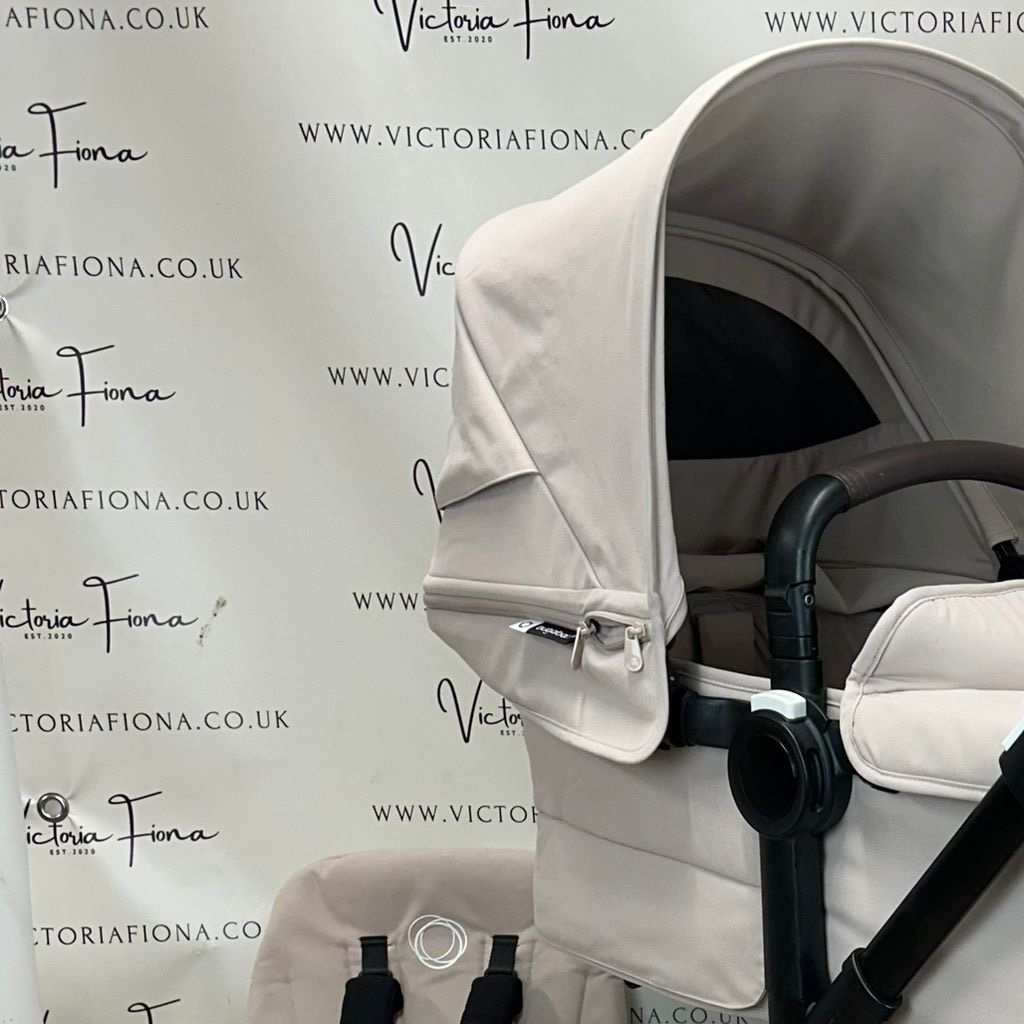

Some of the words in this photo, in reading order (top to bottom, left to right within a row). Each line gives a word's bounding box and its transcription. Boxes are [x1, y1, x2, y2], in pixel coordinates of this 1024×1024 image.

[5, 6, 210, 31] AFIONA.CO.UK
[375, 0, 510, 52] Victoria
[512, 0, 616, 60] Fiona
[27, 101, 149, 189] Fiona
[4, 253, 244, 280] RIAFIONA.CO.UK
[56, 344, 177, 428] Fiona
[0, 578, 90, 632] ictoria
[82, 573, 200, 654] Fiona
[24, 798, 114, 848] ictoria
[107, 791, 220, 868] Fiona
